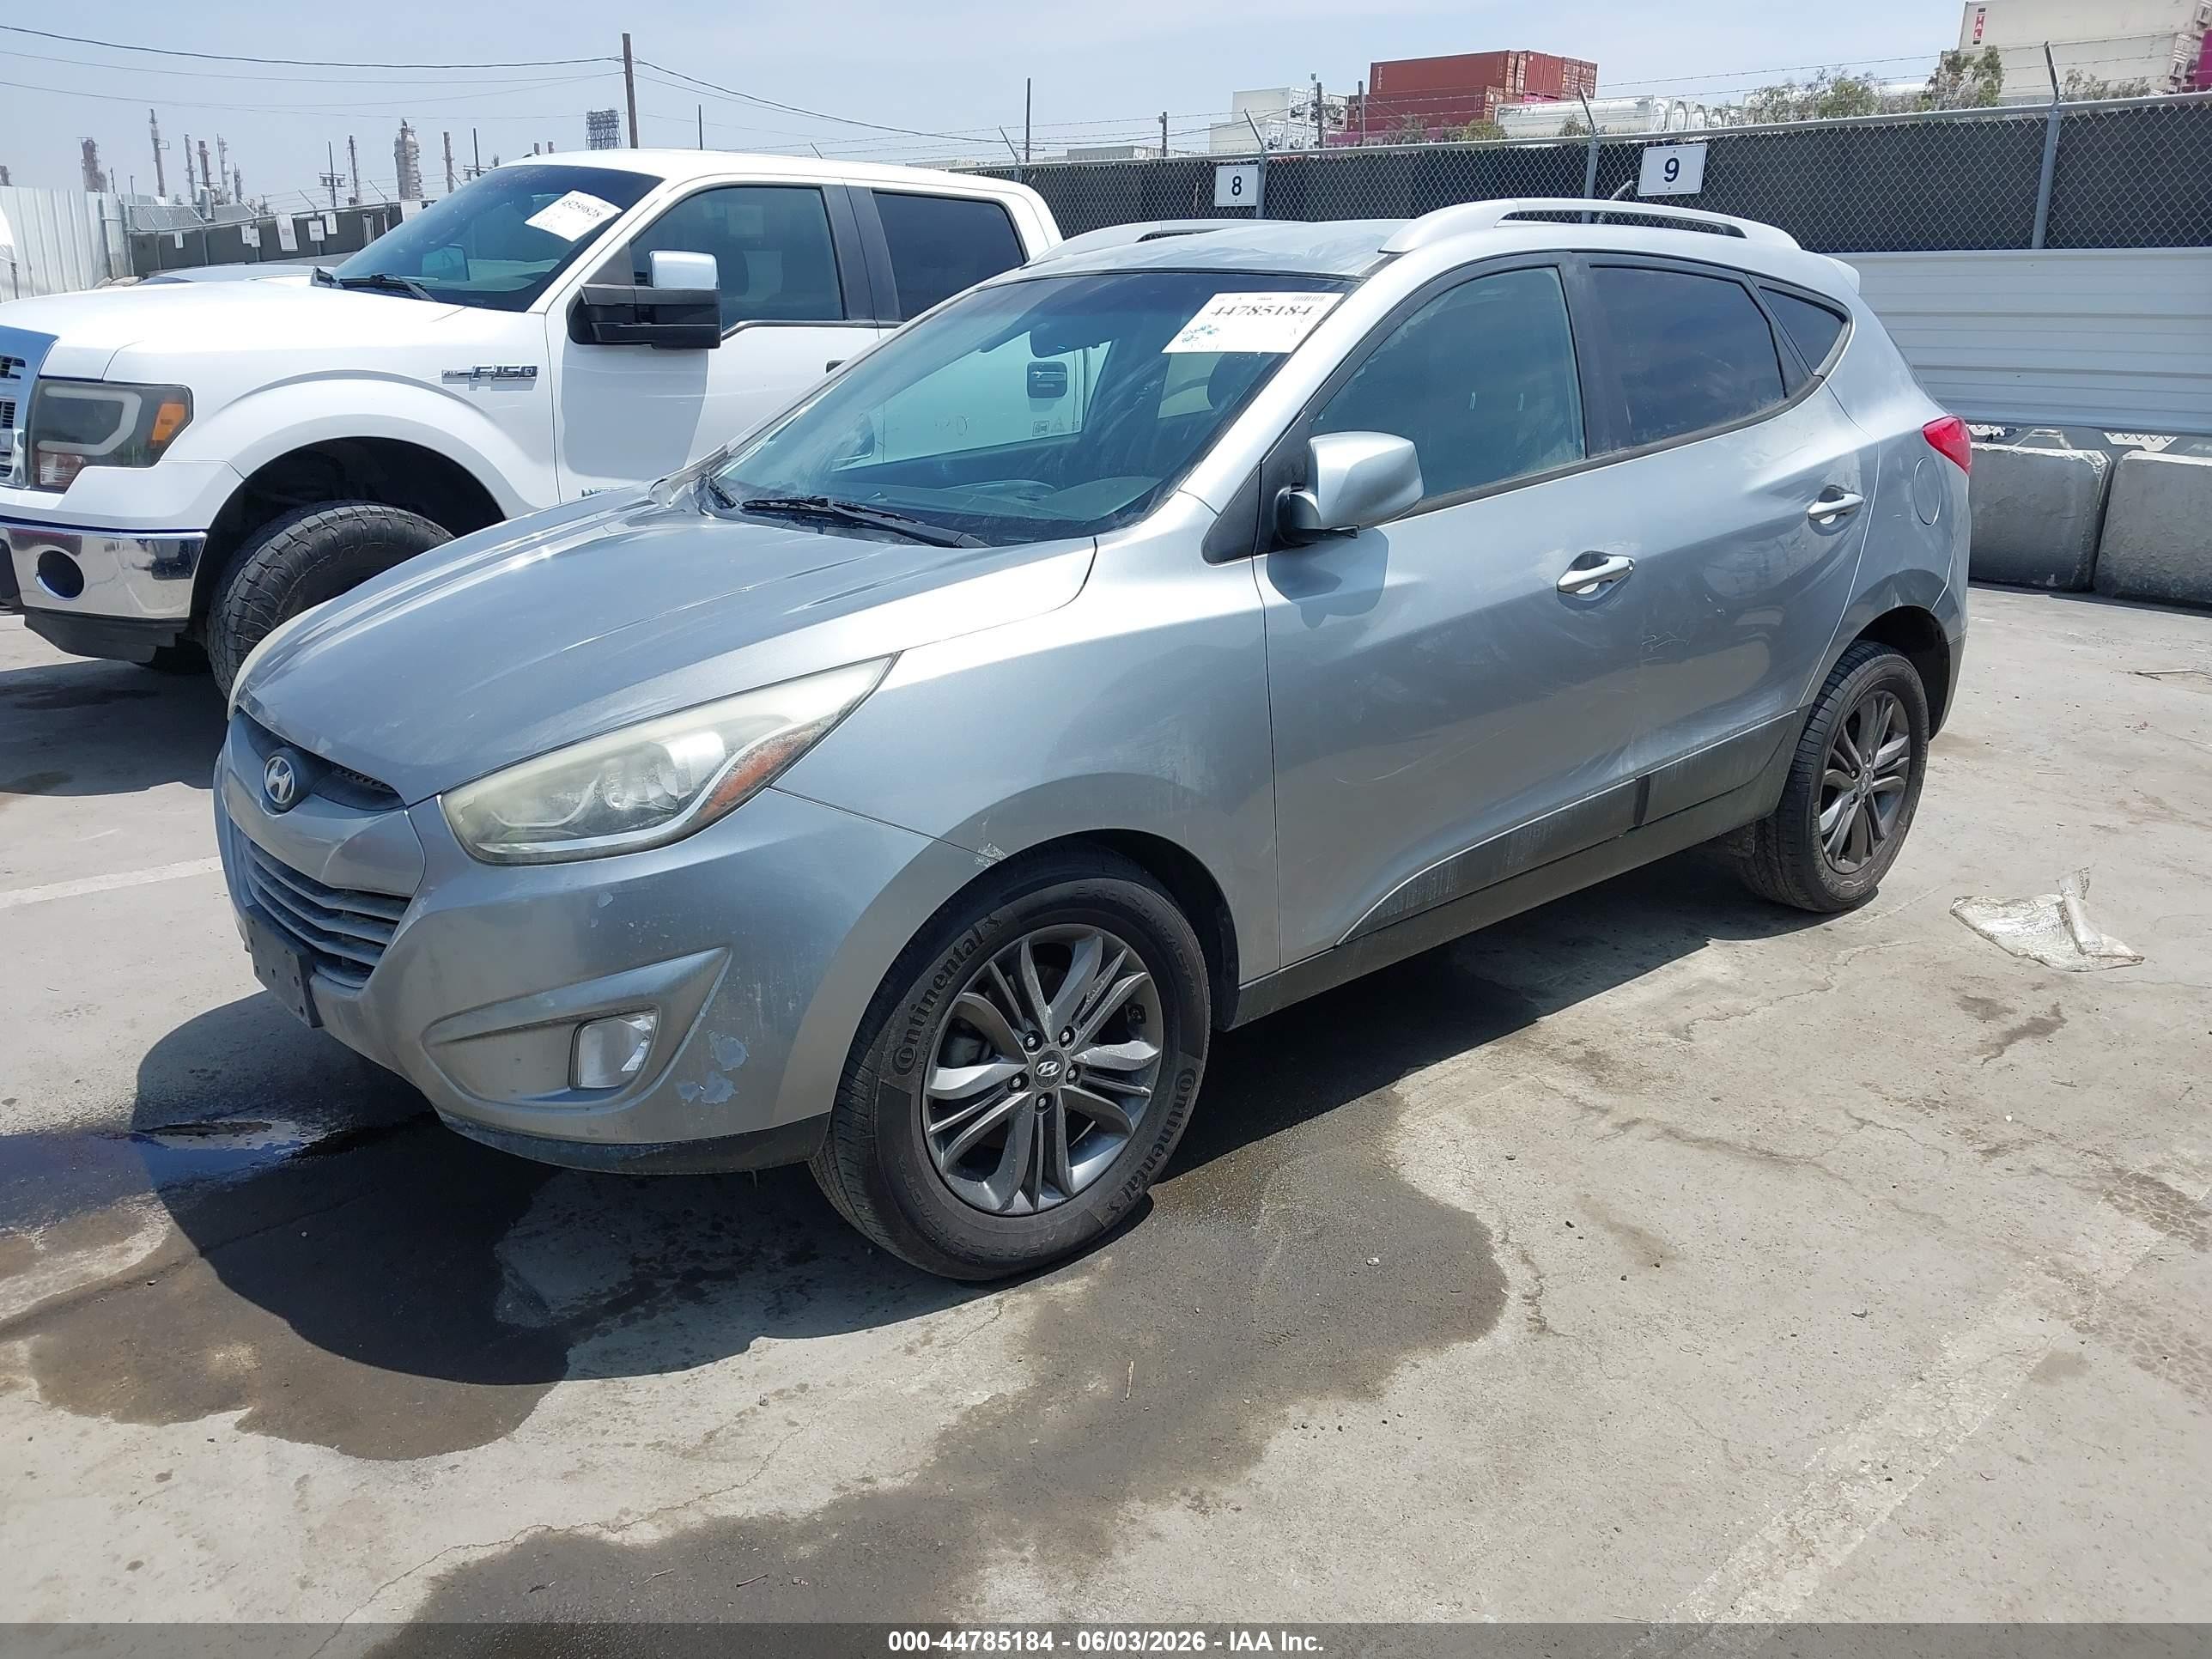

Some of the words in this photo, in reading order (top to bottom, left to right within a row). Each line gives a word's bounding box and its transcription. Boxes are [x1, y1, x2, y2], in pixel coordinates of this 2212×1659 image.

[1974, 14, 1984, 39] TAL
[1663, 157, 1680, 182] 9
[1231, 175, 1243, 196] 8
[1210, 305, 1315, 316] 44785184
[471, 365, 538, 380] F-150
[891, 926, 984, 1076] Continental
[1120, 1067, 1197, 1201] Continental
